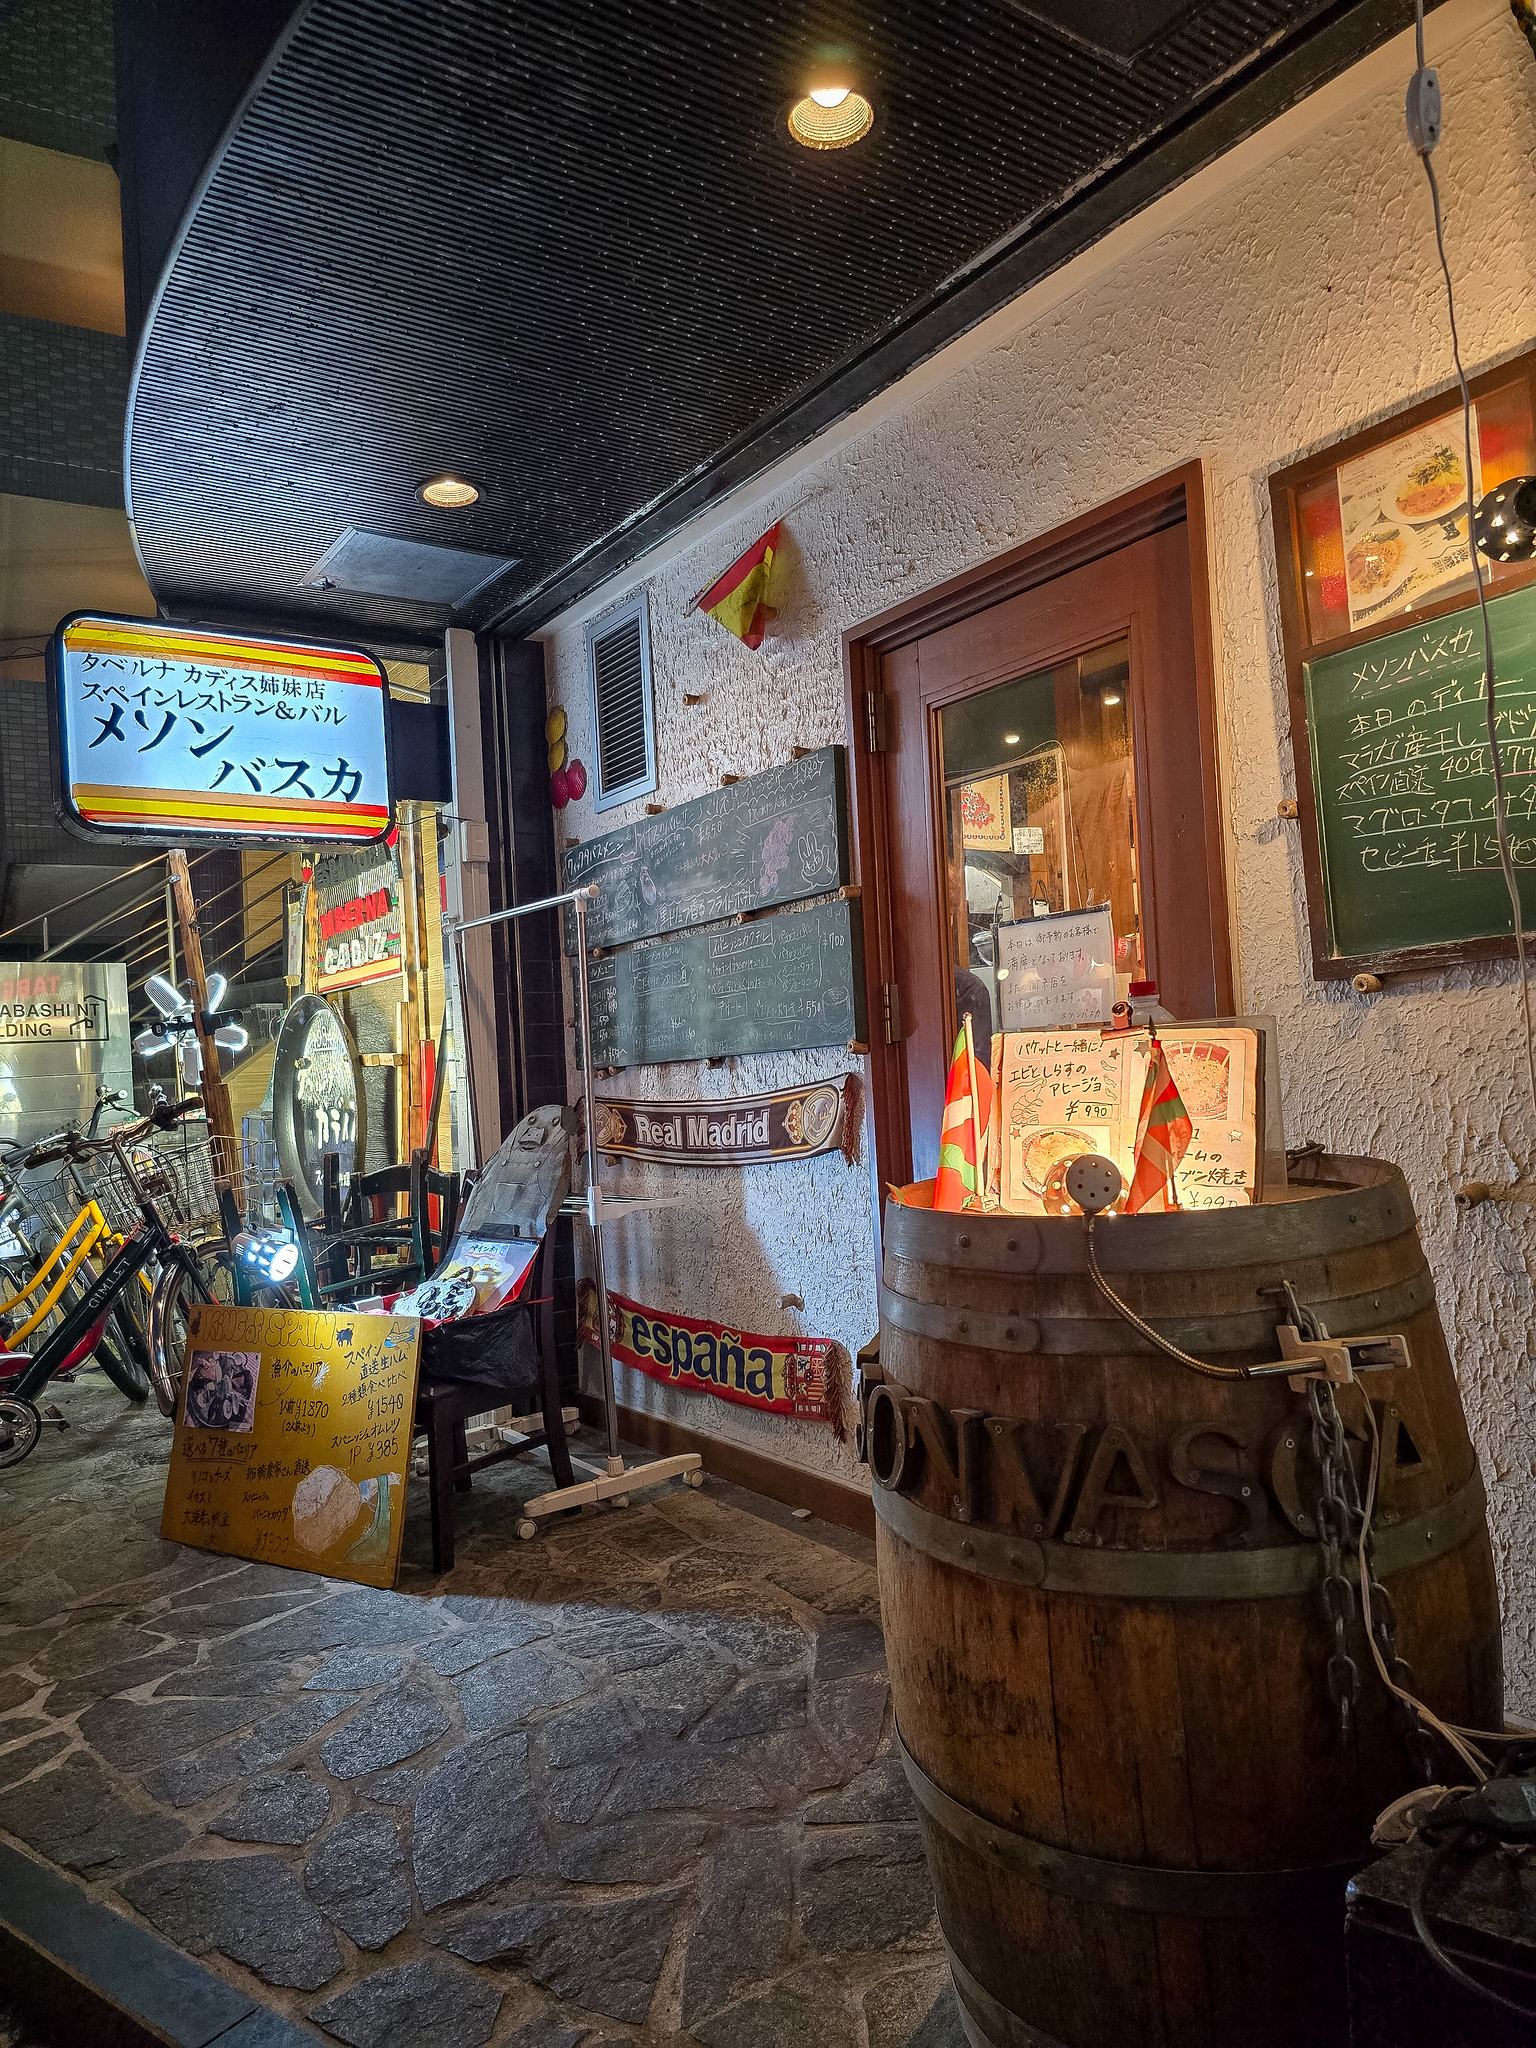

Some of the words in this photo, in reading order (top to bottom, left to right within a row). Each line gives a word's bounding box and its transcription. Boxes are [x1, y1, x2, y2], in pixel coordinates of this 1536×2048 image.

[81, 654, 176, 681] タベルナ
[184, 665, 327, 700] カディス姉妹店
[81, 681, 348, 726] スペインレストラン&バル
[88, 703, 235, 759] メソン
[209, 757, 363, 802] バスカ
[0, 1004, 70, 1017] ABASHI
[78, 1003, 99, 1016] NT
[1008, 1062, 1088, 1083] エビとしらすの
[1049, 1079, 1103, 1098] アヒージョ
[633, 1113, 682, 1148] Real
[686, 1108, 771, 1149] Madrid
[1176, 1167, 1248, 1186] ブン焼き
[88, 1257, 131, 1308] GIMLET
[264, 1310, 338, 1351] SPAIN
[344, 1343, 383, 1370] スペイン
[359, 1352, 408, 1381] 直送生ハム
[631, 1315, 774, 1402] españa
[341, 1370, 408, 1407] 2種類食べ比べ
